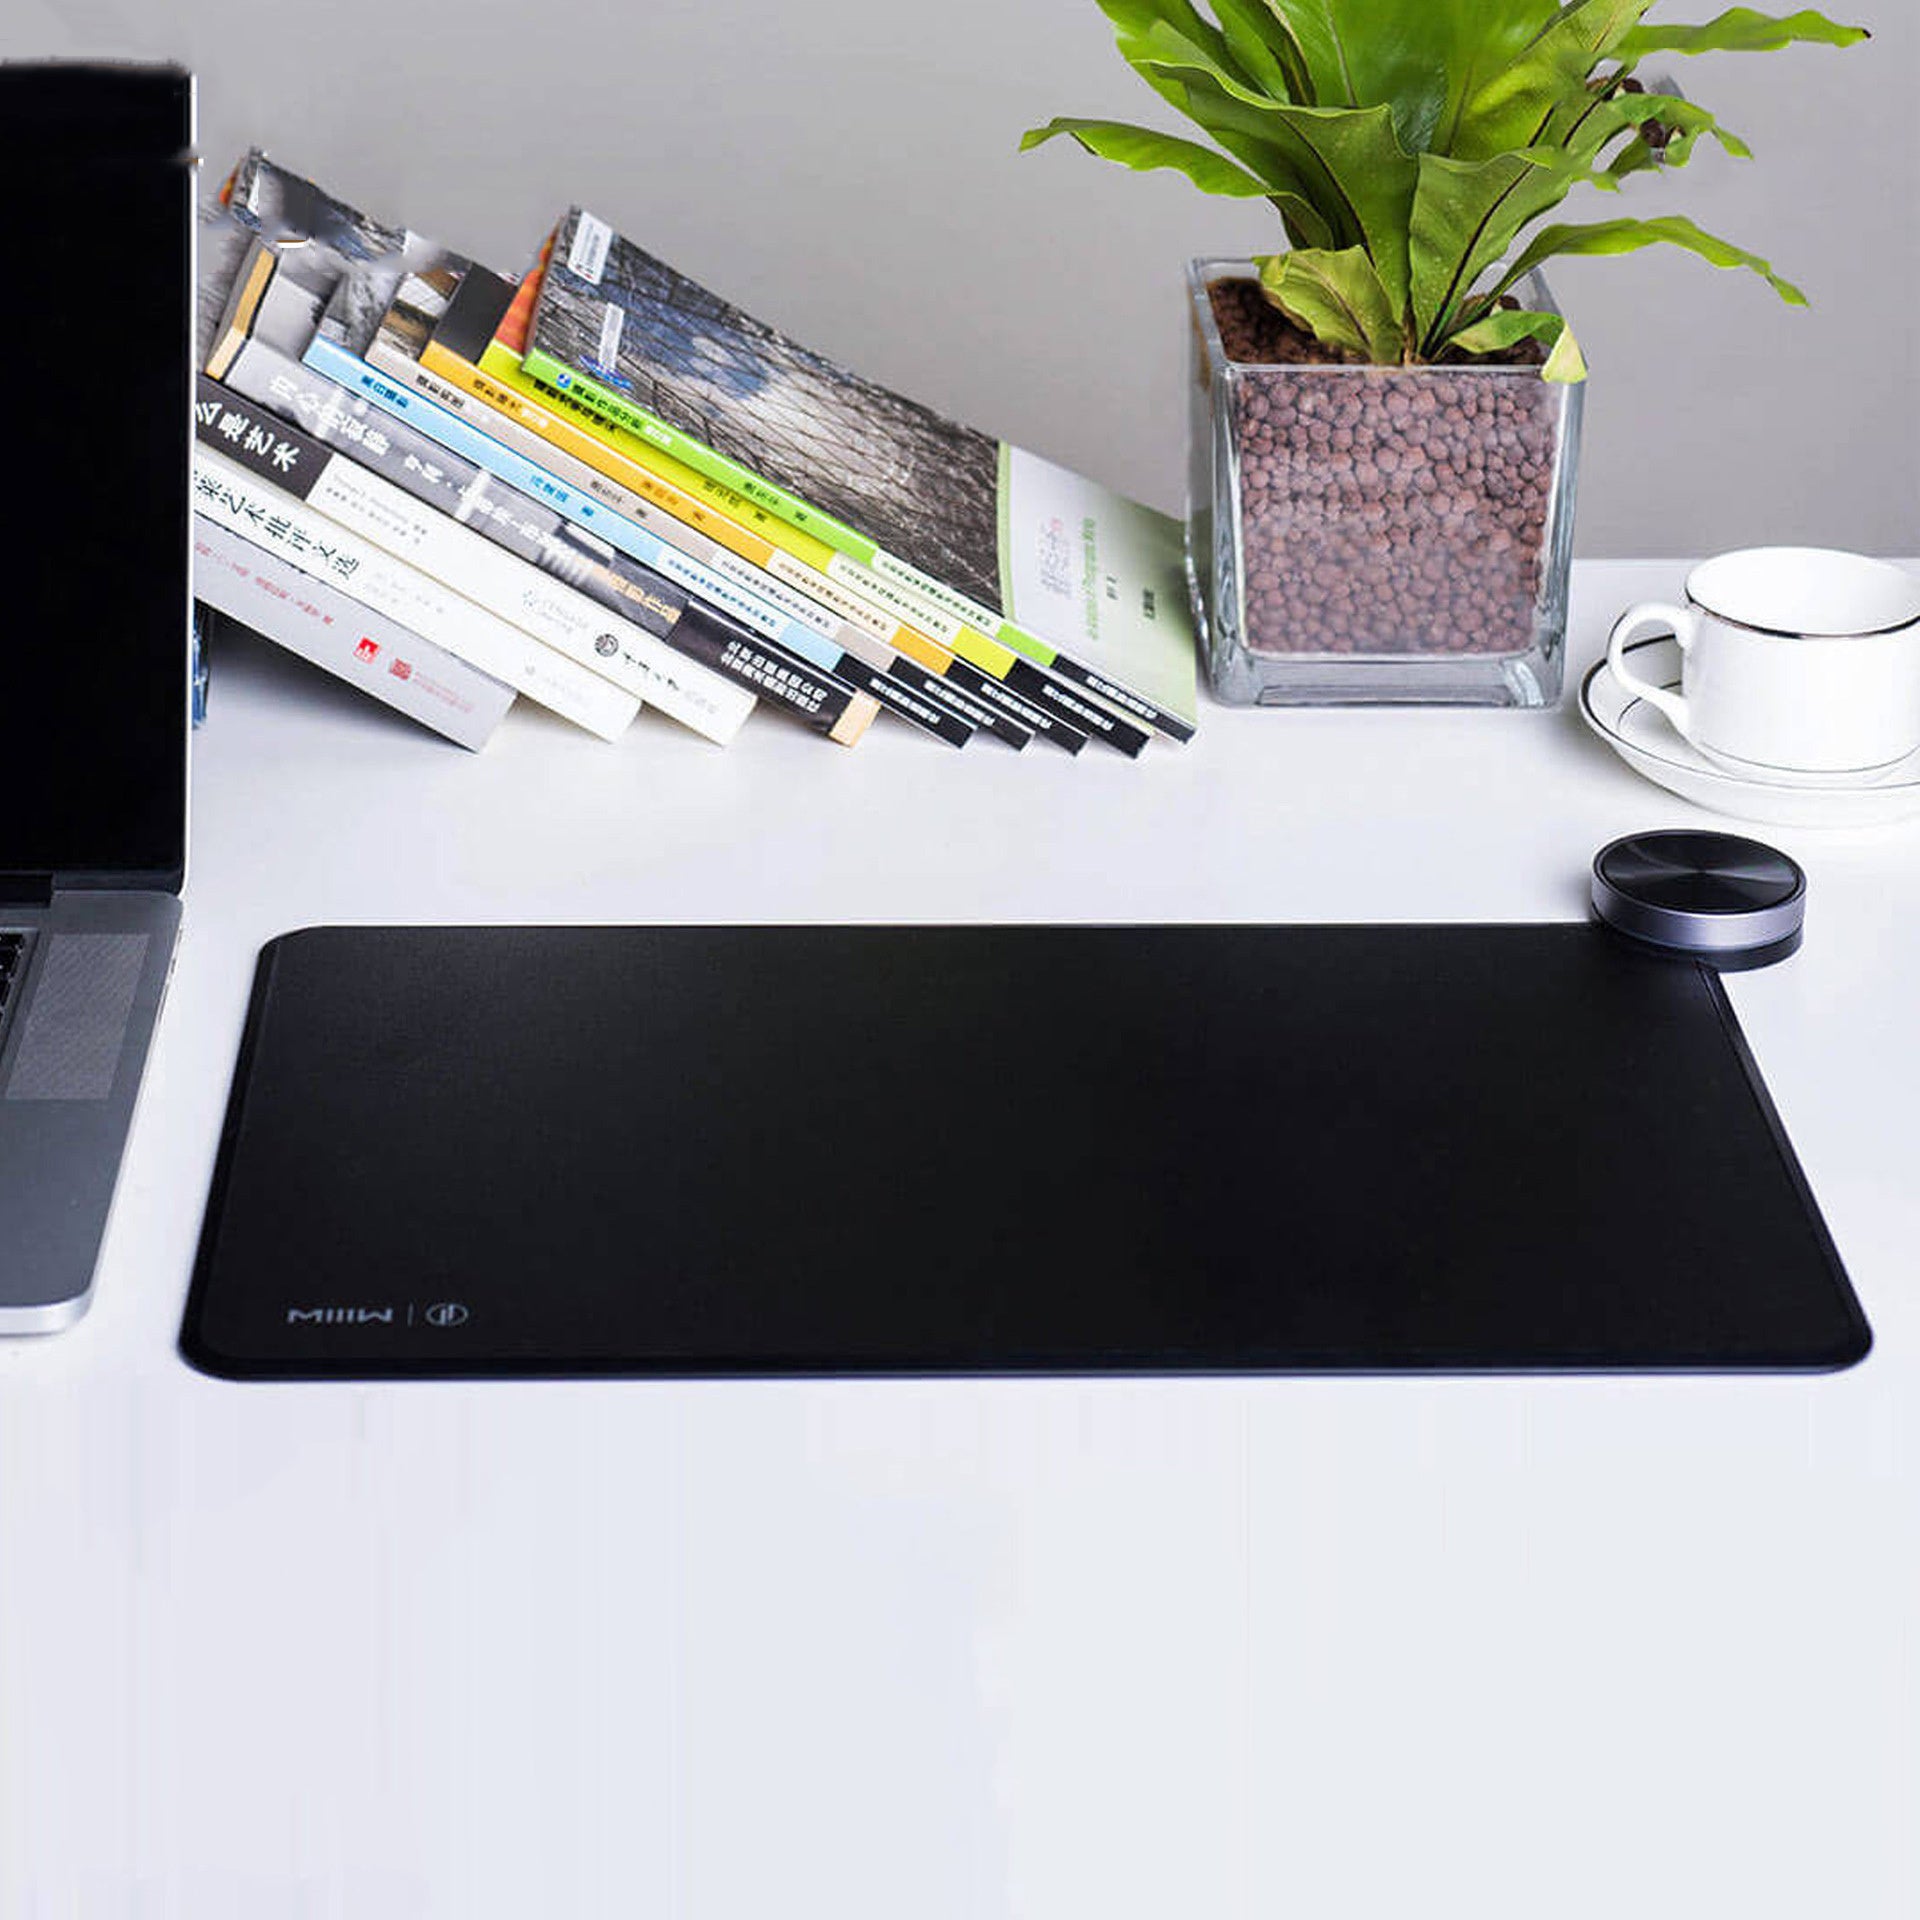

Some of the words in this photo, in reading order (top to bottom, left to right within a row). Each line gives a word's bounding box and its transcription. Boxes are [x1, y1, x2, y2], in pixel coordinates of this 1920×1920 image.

[194, 470, 360, 580] 莱艺术批评文选
